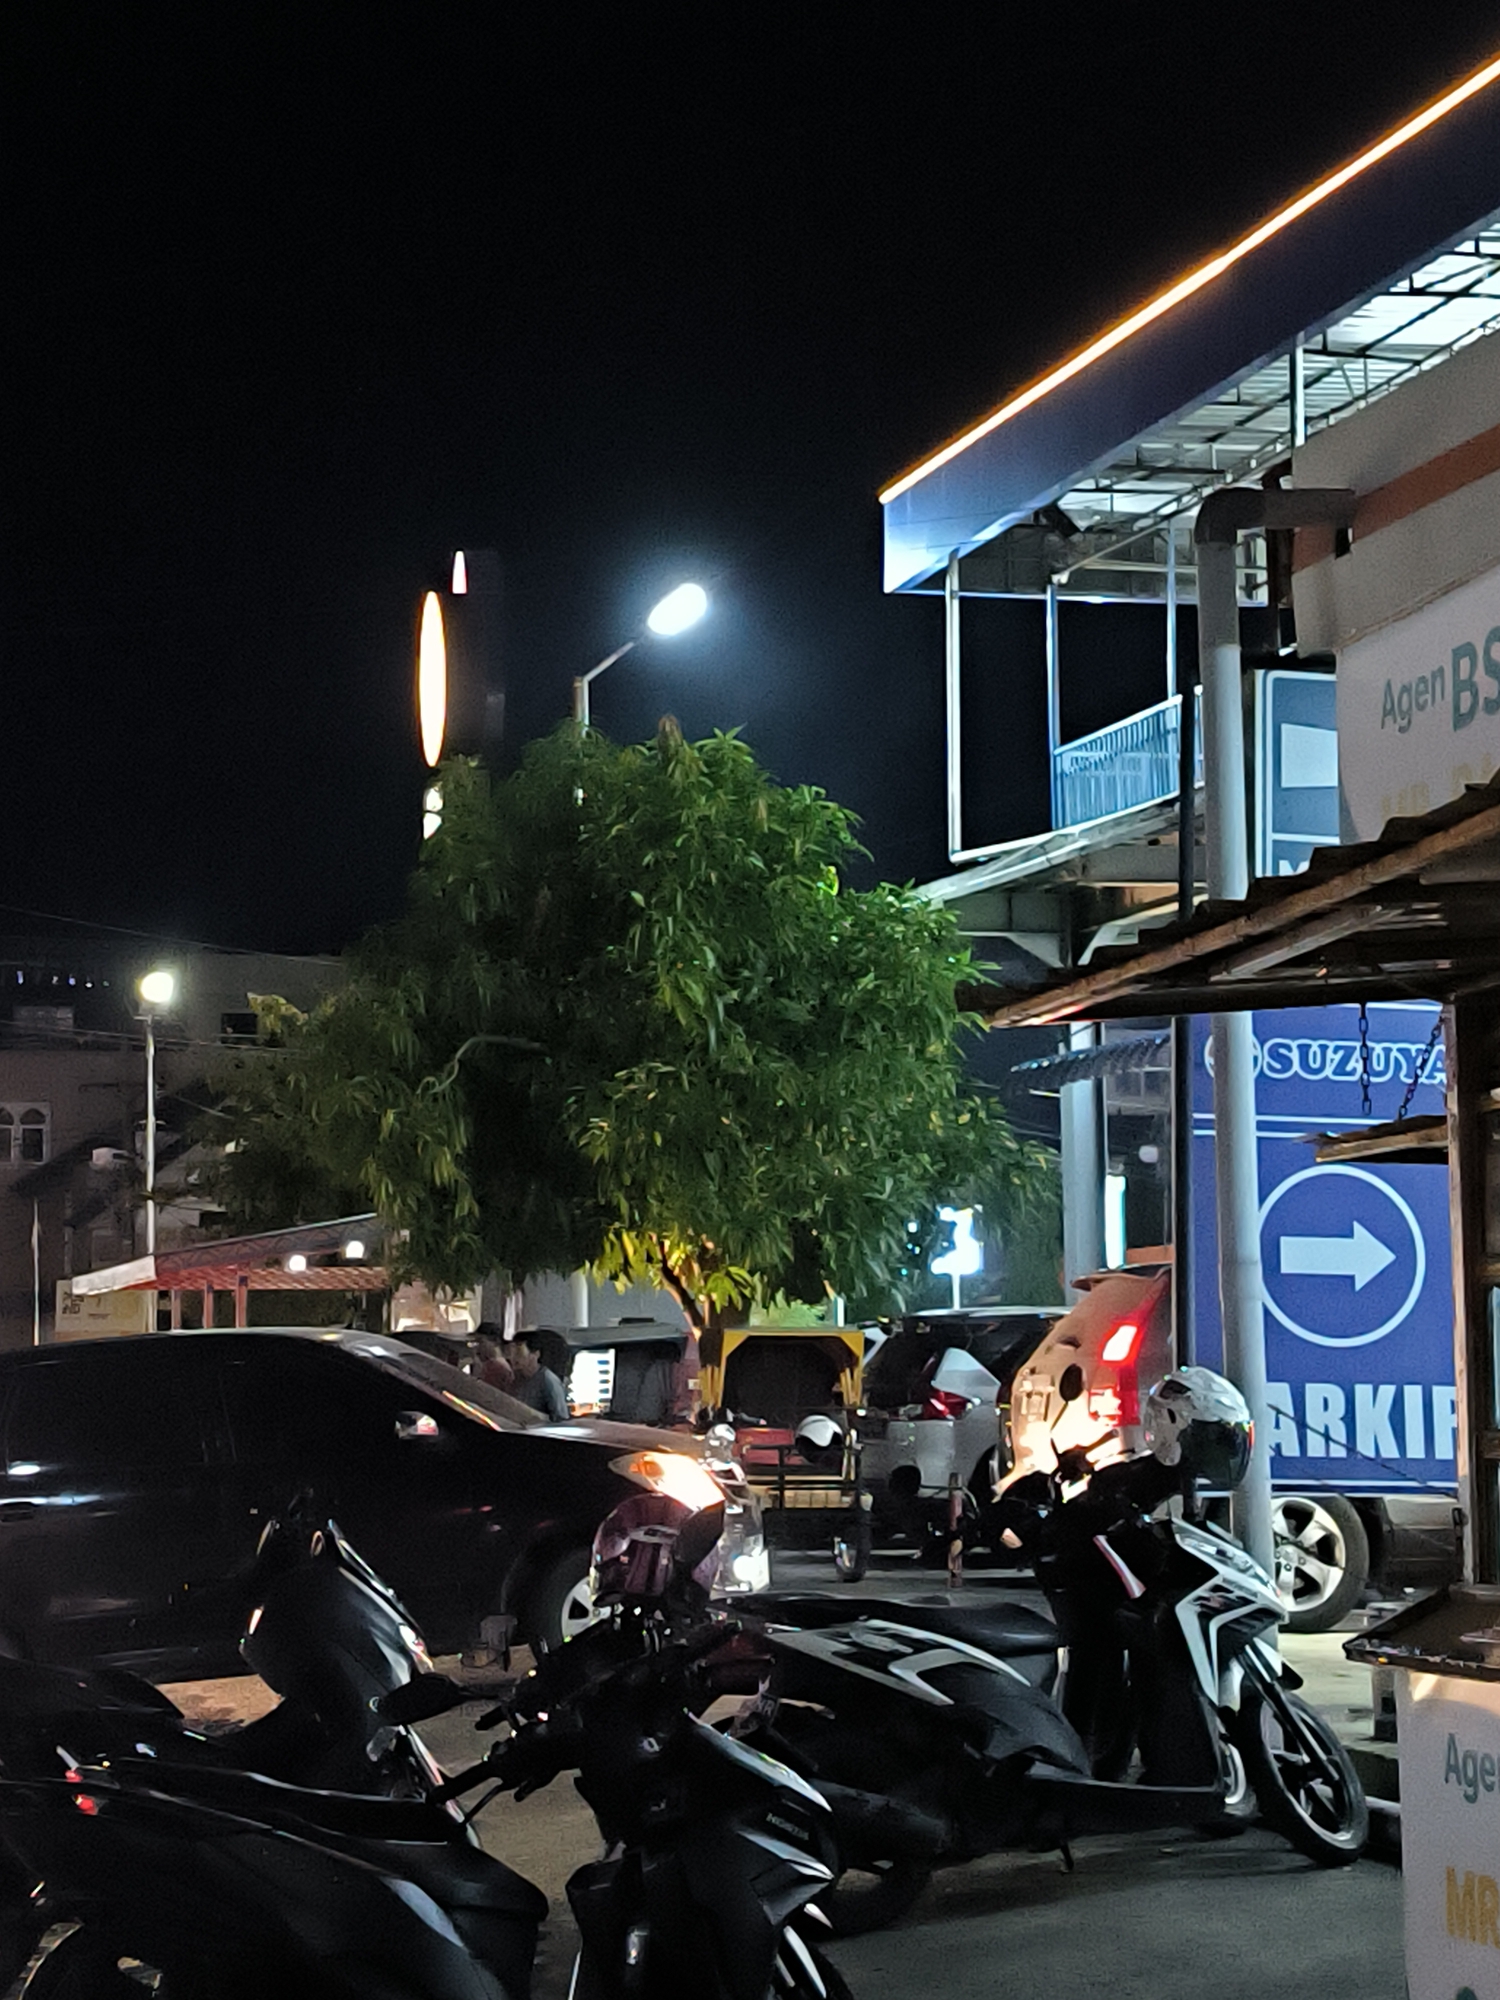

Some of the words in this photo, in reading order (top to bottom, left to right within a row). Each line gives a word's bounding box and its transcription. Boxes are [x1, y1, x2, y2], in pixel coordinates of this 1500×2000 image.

[1381, 665, 1446, 733] Agen
[1263, 1038, 1447, 1083] SUZUYA
[1444, 1733, 1500, 1804] Age
